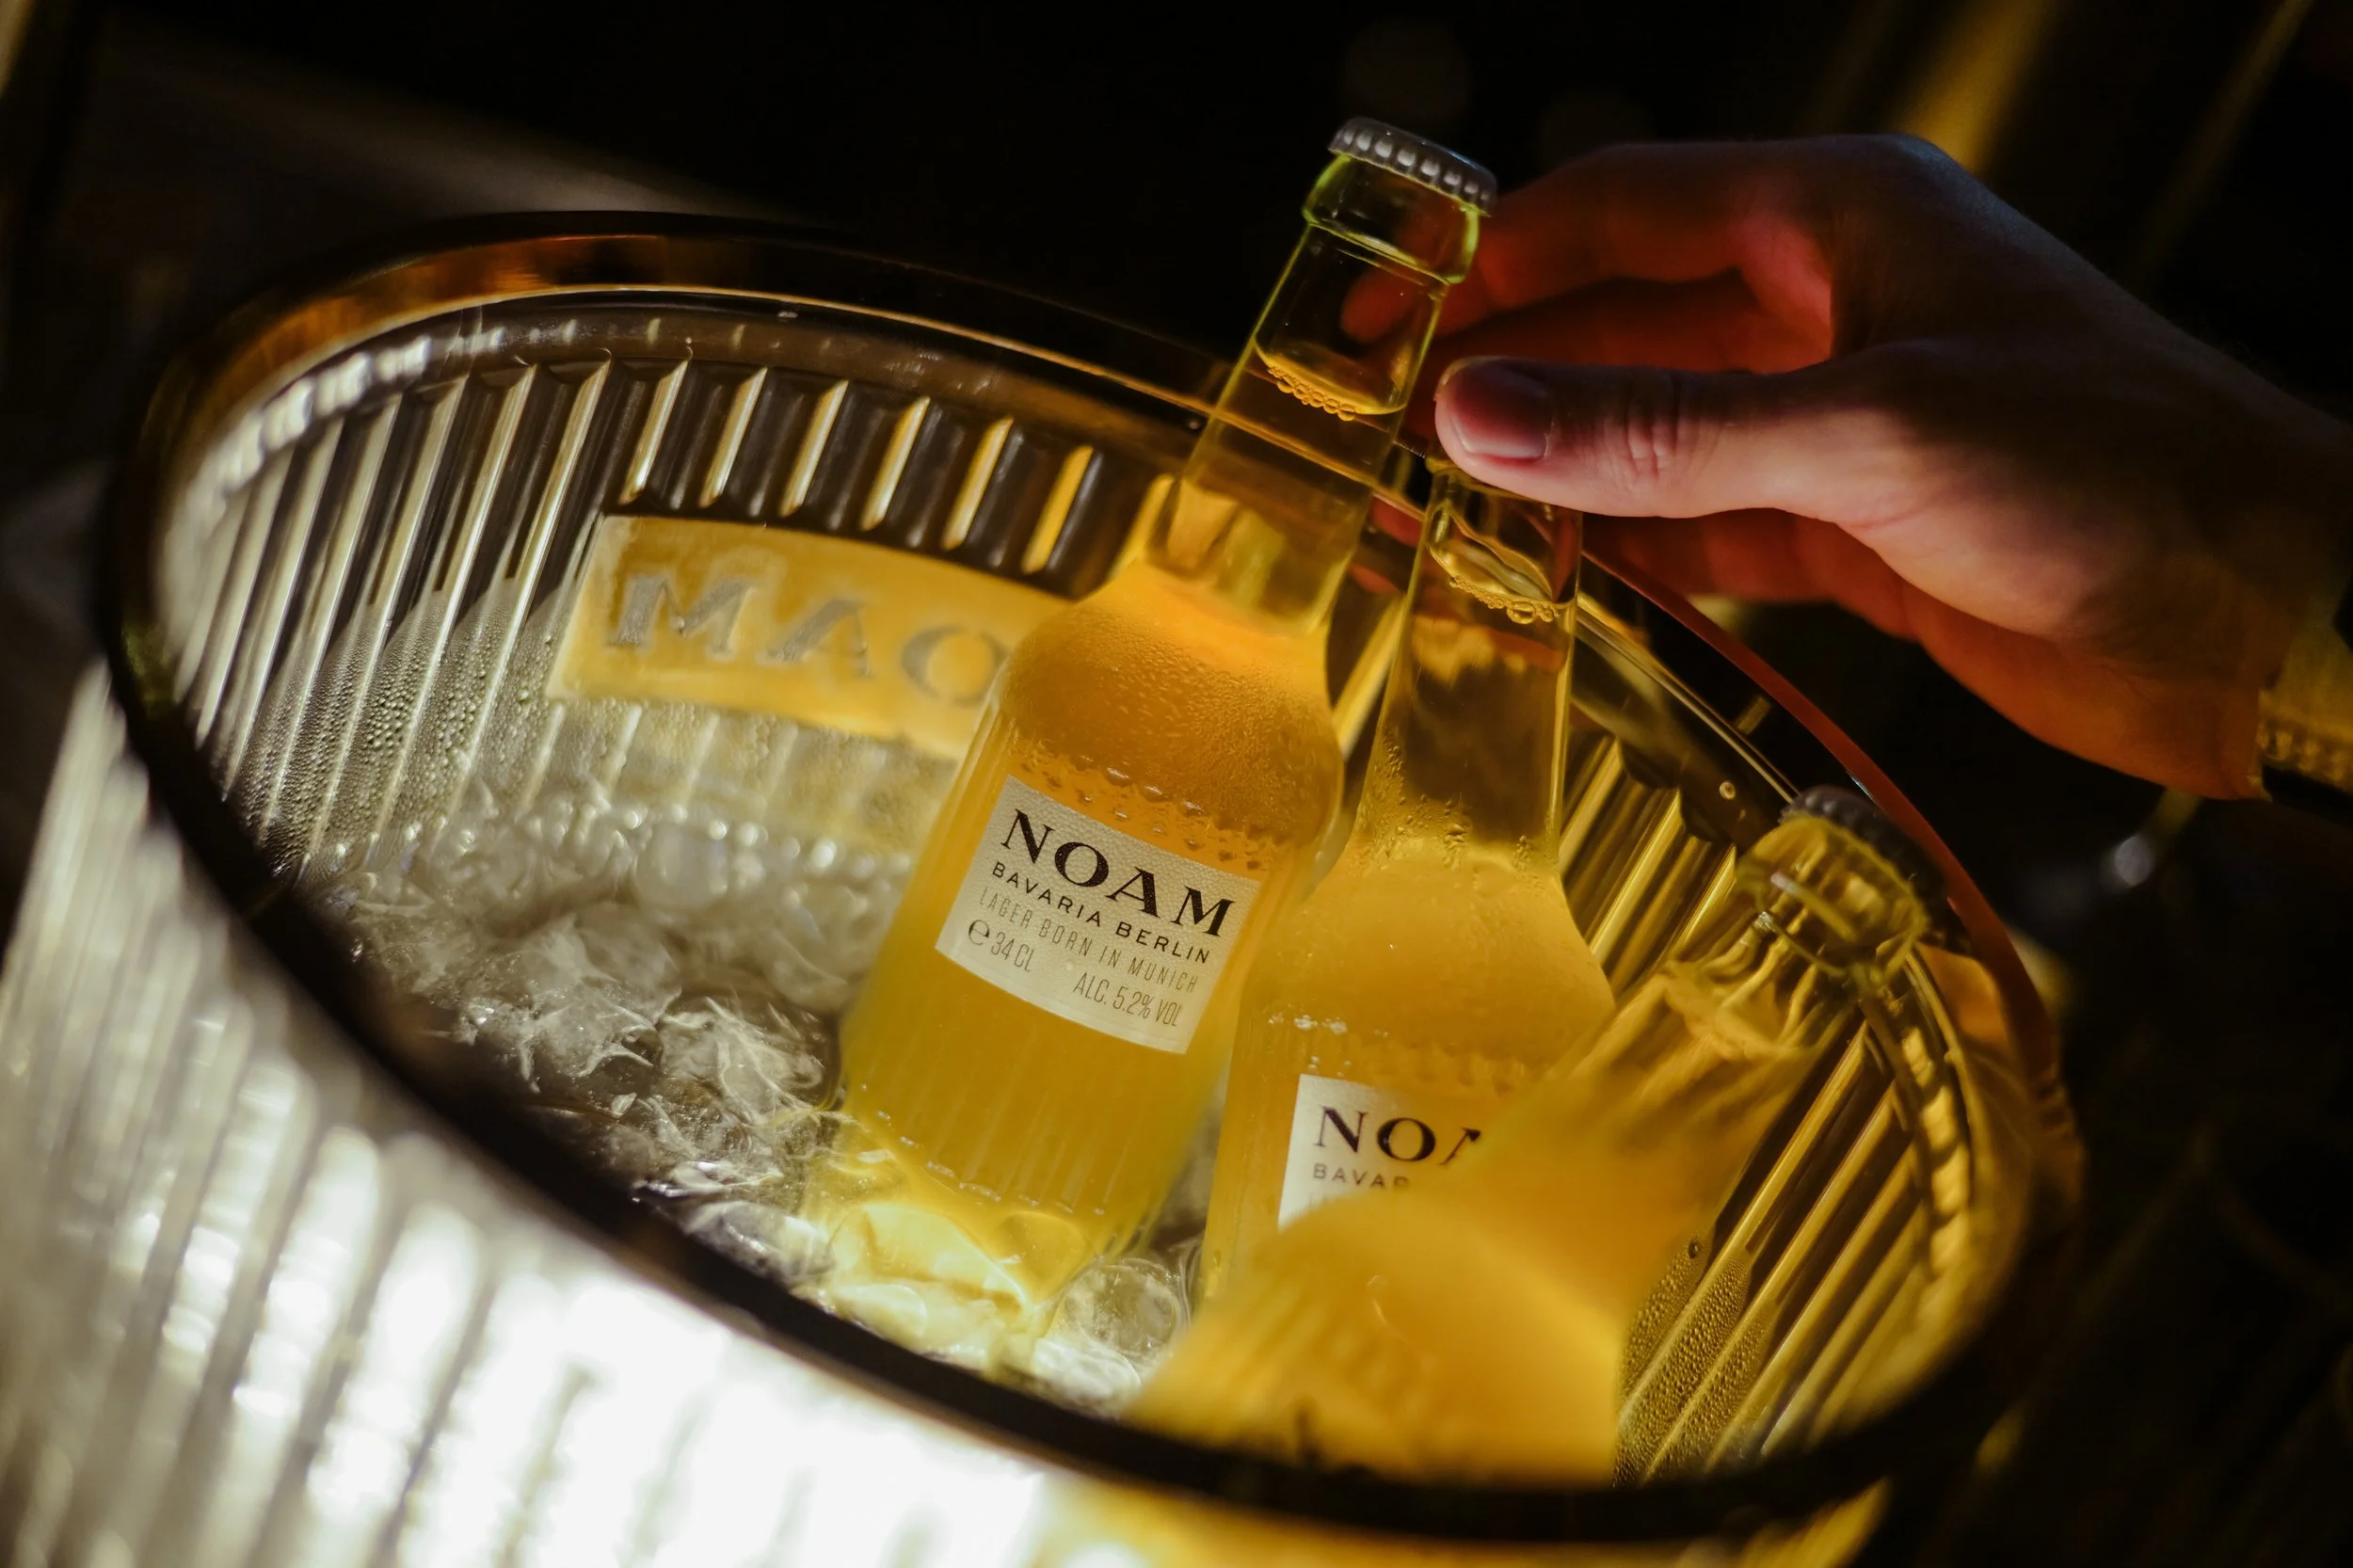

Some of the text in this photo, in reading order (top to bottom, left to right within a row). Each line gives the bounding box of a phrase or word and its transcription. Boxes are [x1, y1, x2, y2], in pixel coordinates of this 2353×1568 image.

[992, 861, 1210, 964] BAVARIA BERLIN
[1000, 808, 1235, 936] NOAM
[979, 886, 1198, 994] LAGER BORN IN MUNICH
[1072, 971, 1110, 1005] ALC.
[1112, 985, 1155, 1019] 5.2%
[1155, 999, 1182, 1027] VOL
